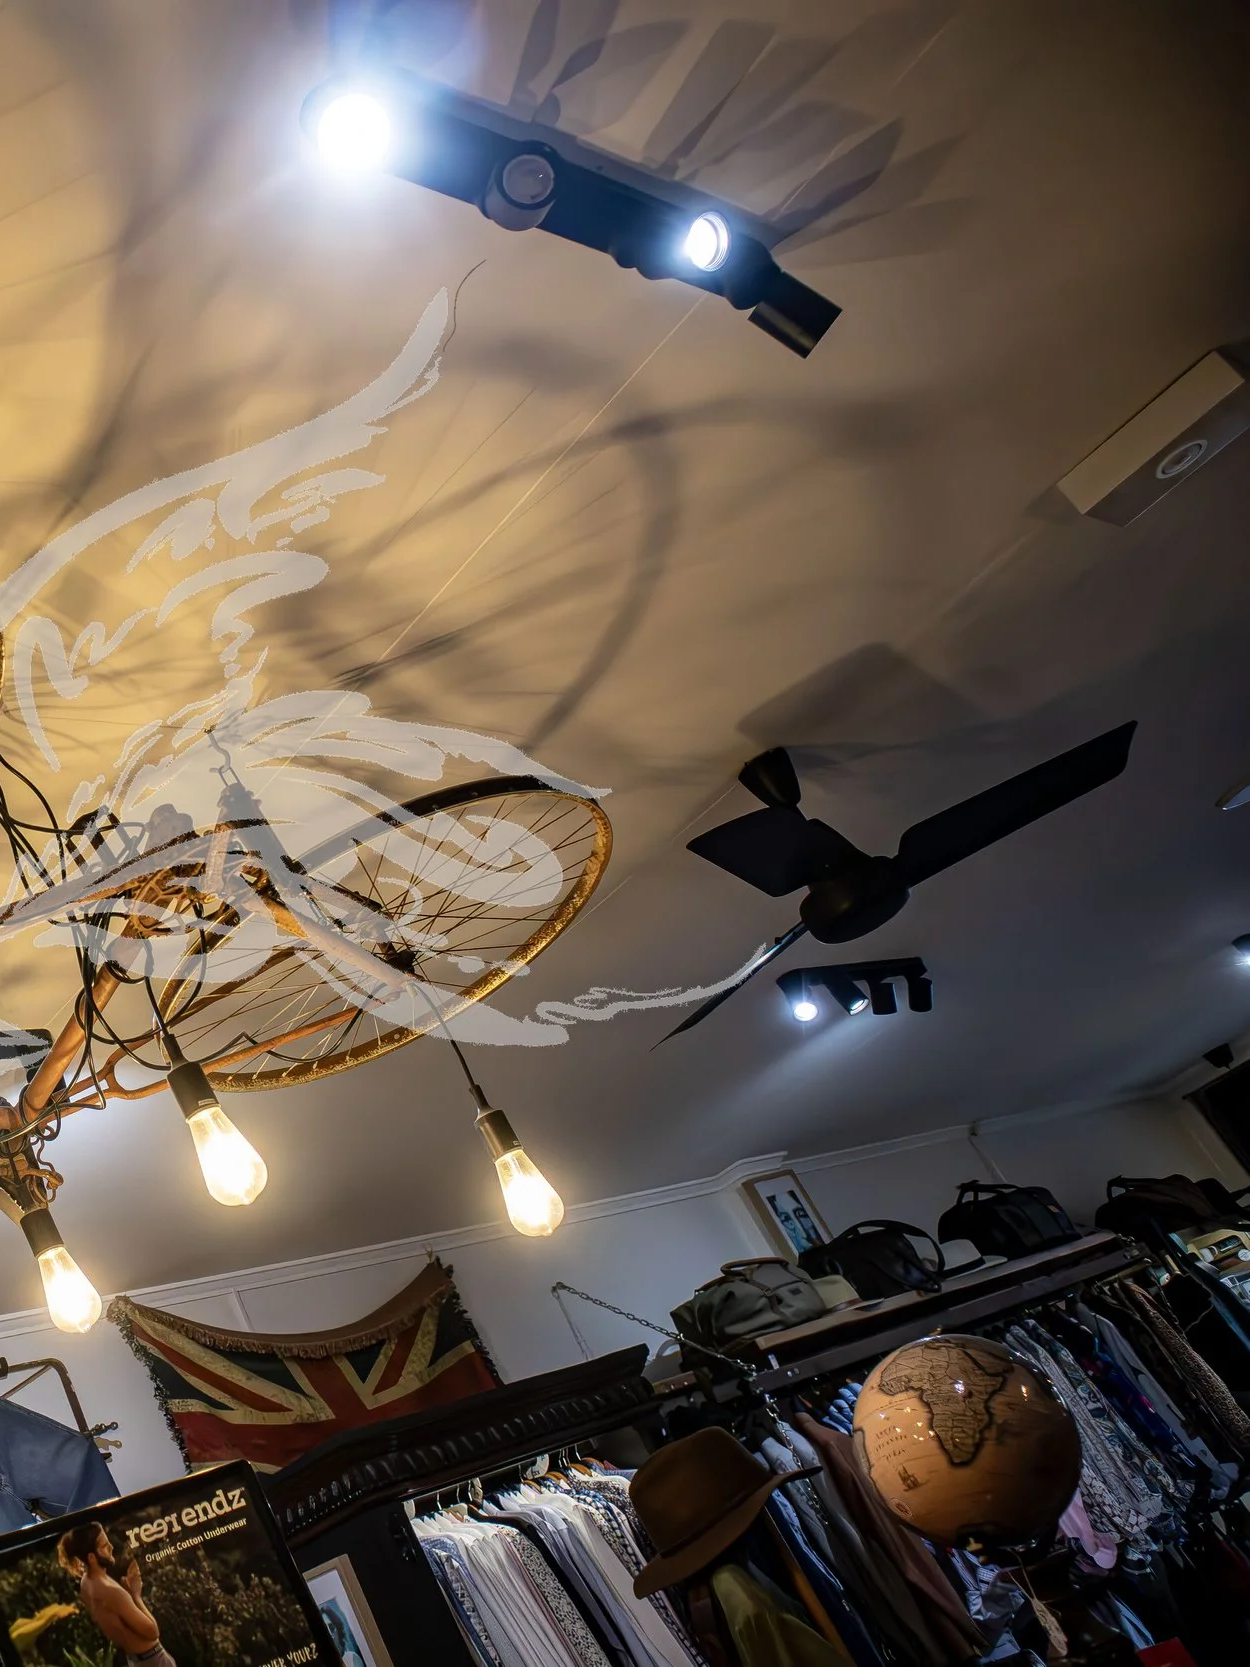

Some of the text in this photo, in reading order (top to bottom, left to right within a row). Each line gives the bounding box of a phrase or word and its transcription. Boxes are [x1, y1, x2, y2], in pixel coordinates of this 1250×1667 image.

[145, 1517, 247, 1562] Organic Cotton Underwear
